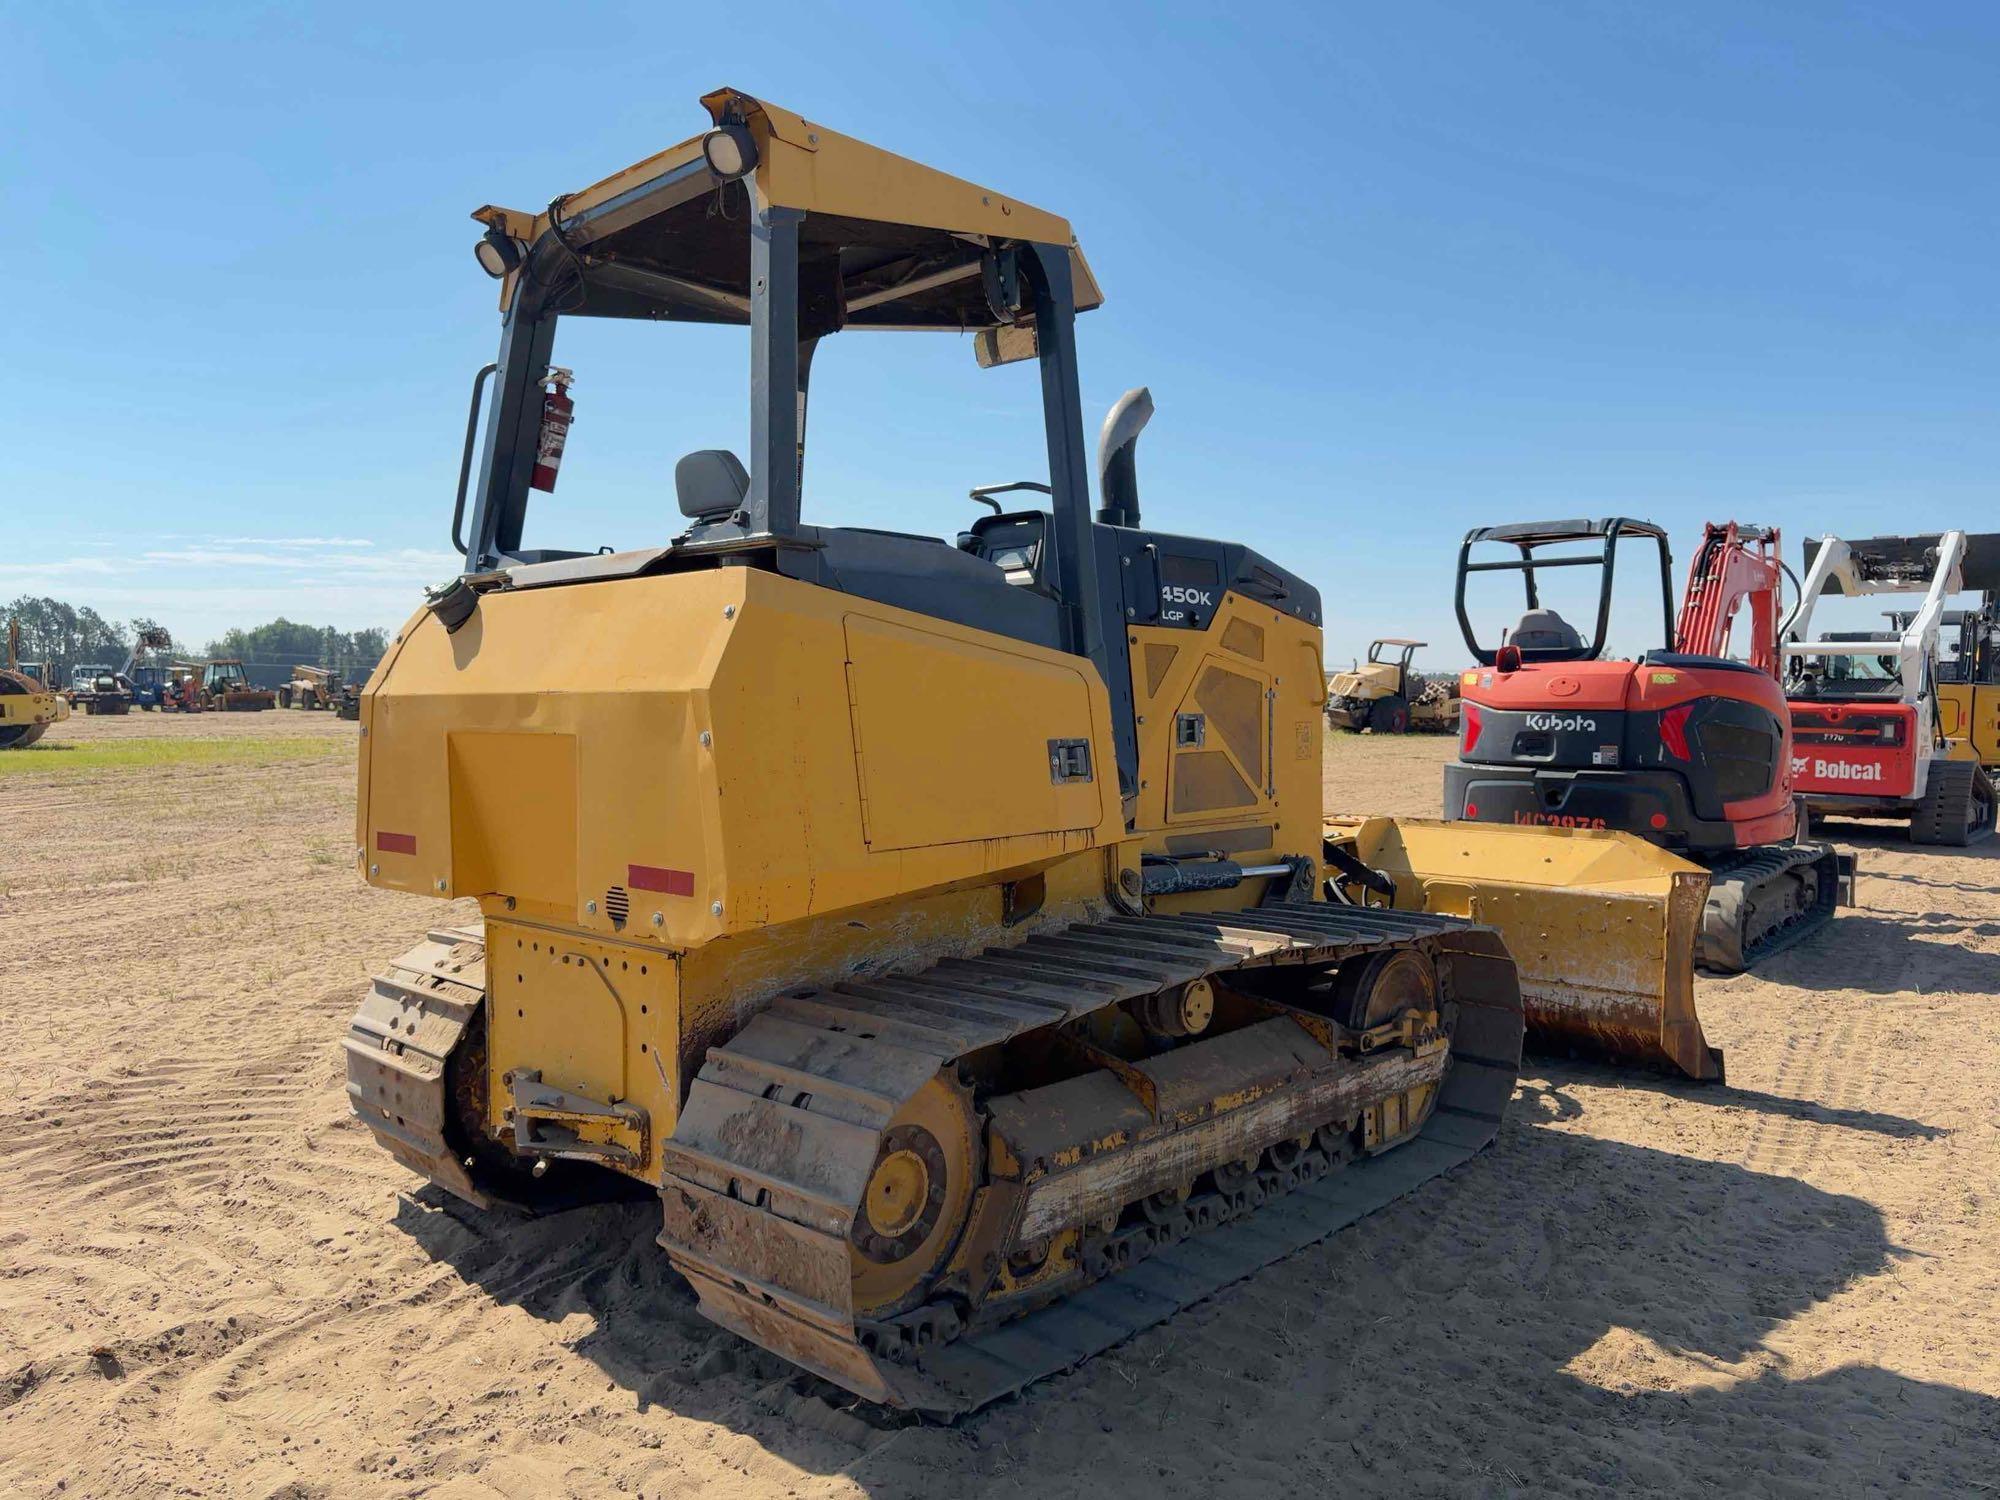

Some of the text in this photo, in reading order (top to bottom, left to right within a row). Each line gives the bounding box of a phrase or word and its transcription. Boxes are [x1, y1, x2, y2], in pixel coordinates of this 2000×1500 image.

[1162, 585, 1212, 606] 450K
[1162, 610, 1184, 621] LGP
[1526, 714, 1596, 732] Kubota
[1815, 759, 1881, 780] Bobcat
